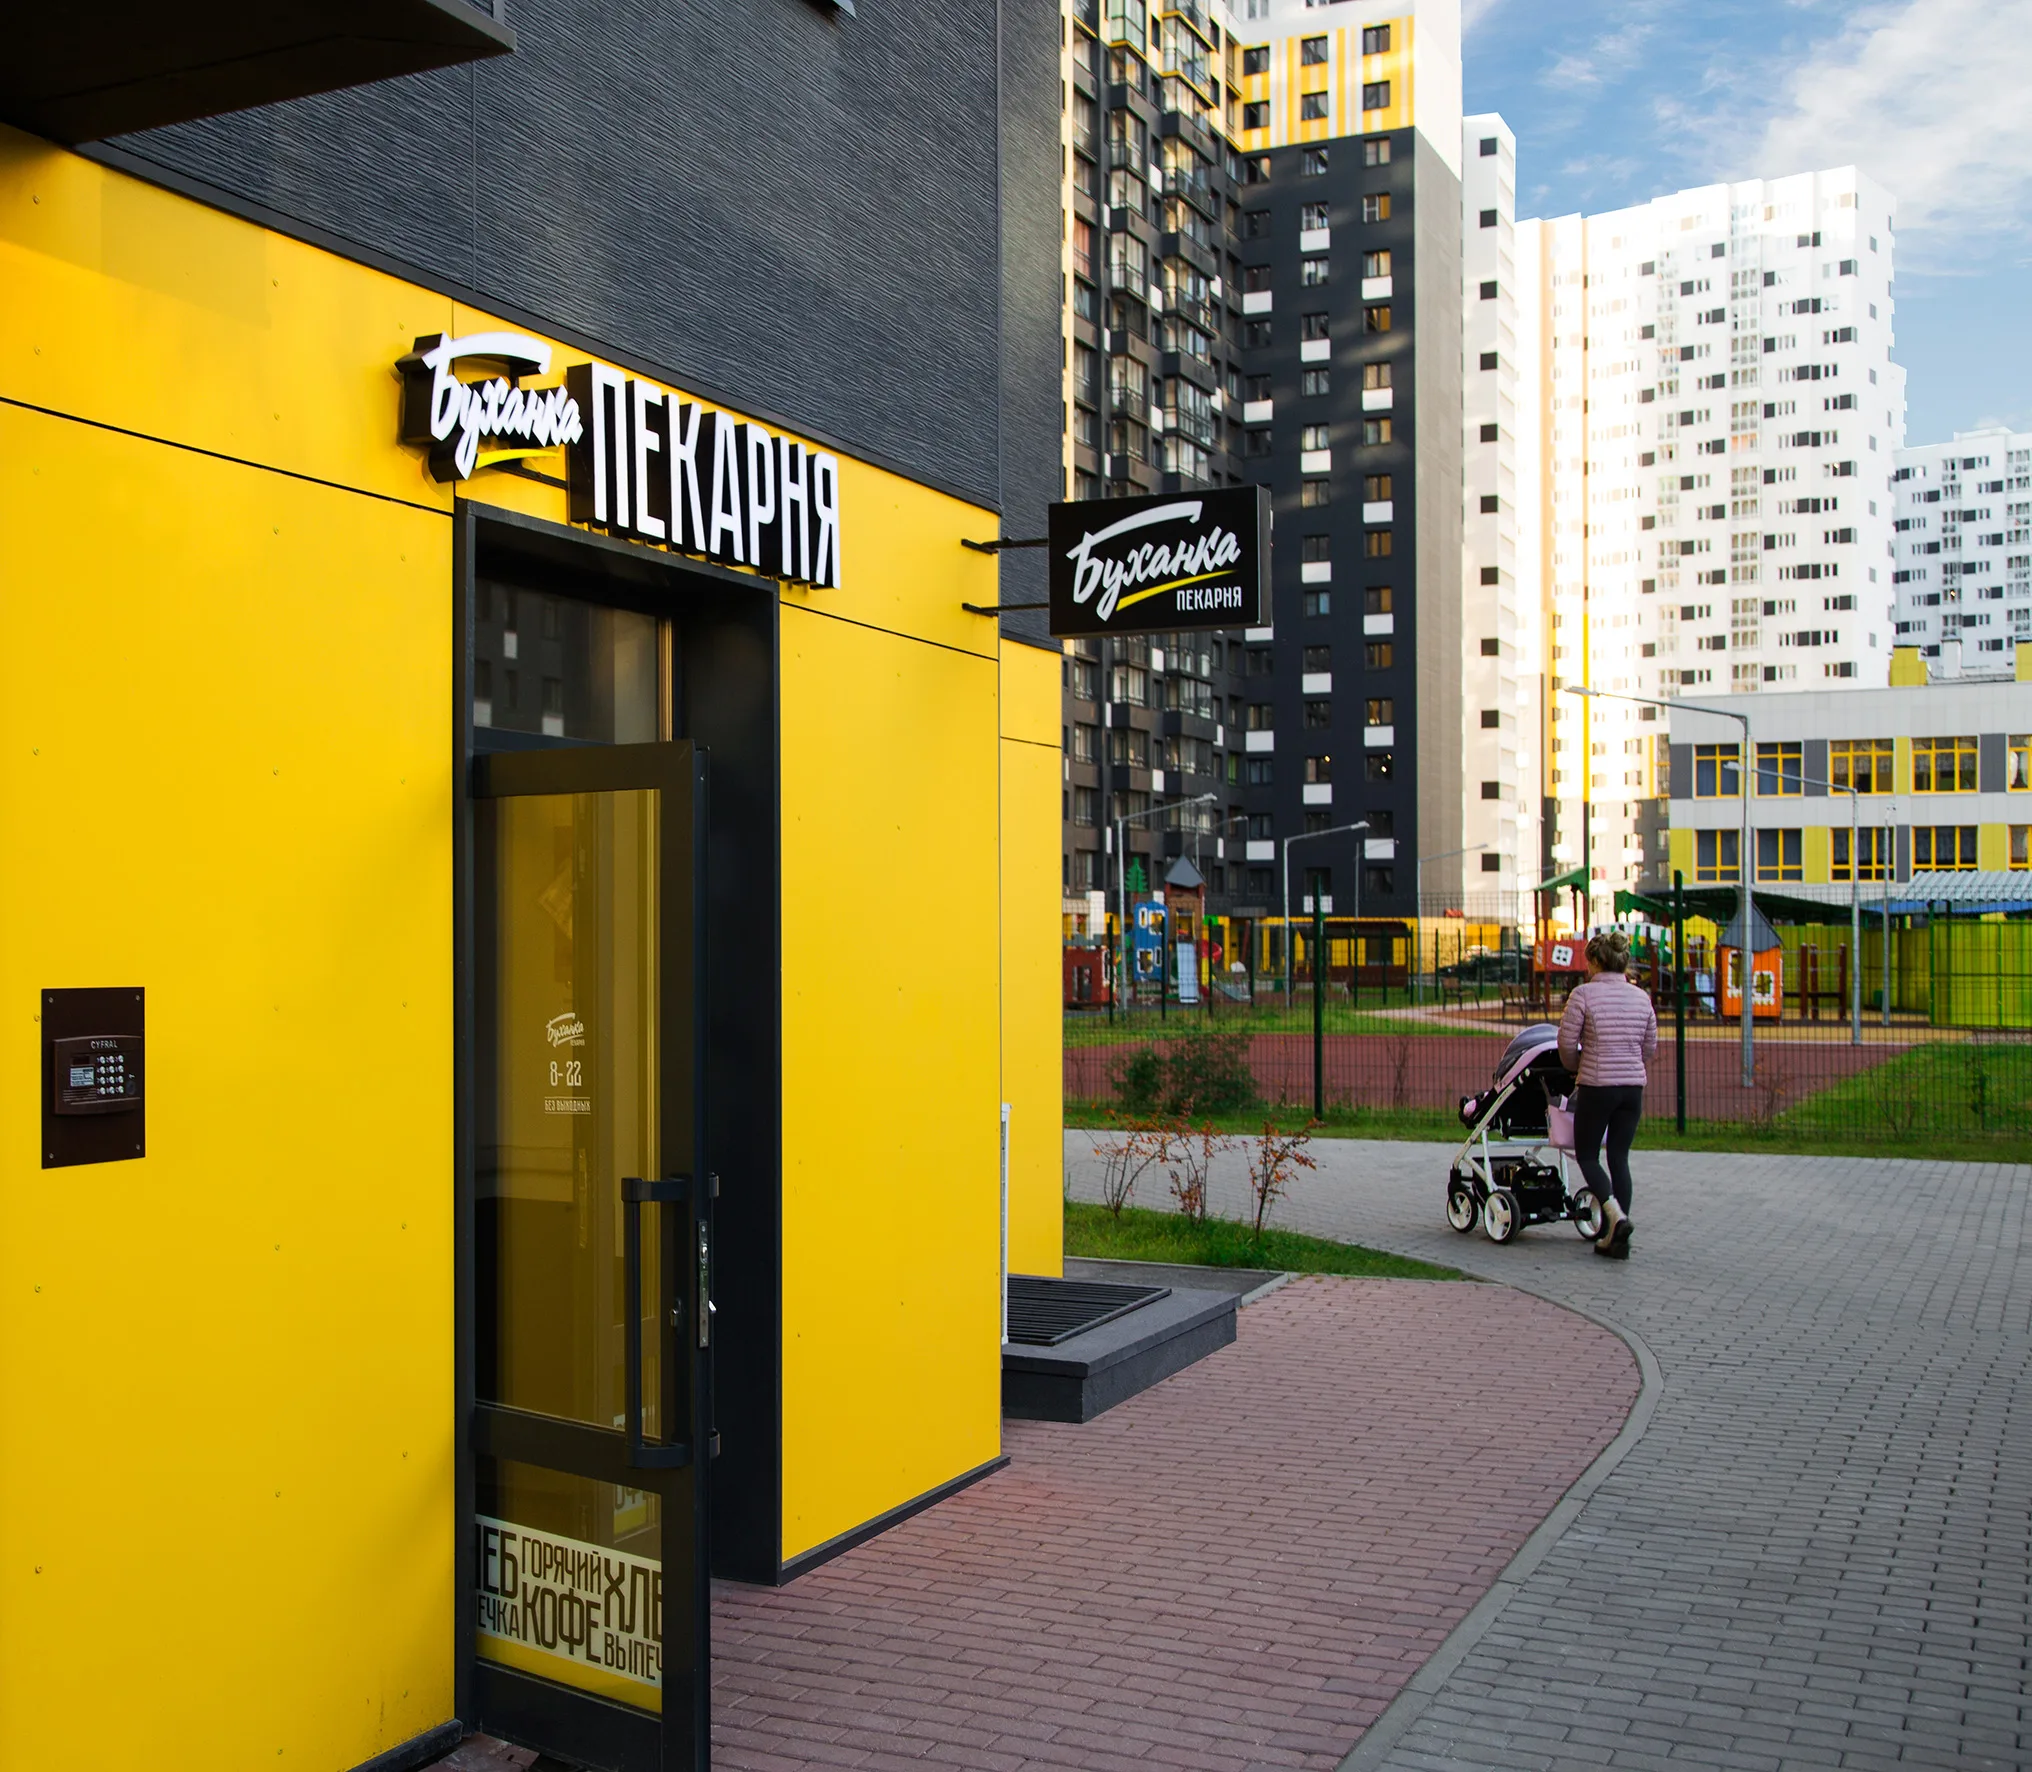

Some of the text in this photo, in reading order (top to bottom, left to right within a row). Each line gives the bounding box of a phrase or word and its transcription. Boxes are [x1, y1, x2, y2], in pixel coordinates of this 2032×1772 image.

[421, 331, 841, 589] Буханка ПЕКАРНЯ
[1066, 501, 1241, 622] Буханка
[1176, 586, 1242, 611] ПЕКАРНЯ
[90, 1040, 118, 1049] CYFRAL
[522, 1536, 601, 1595] ГОРЯЧИЙ
[478, 1594, 520, 1639] ЕЧКА
[522, 1581, 601, 1664] КОФЕ
